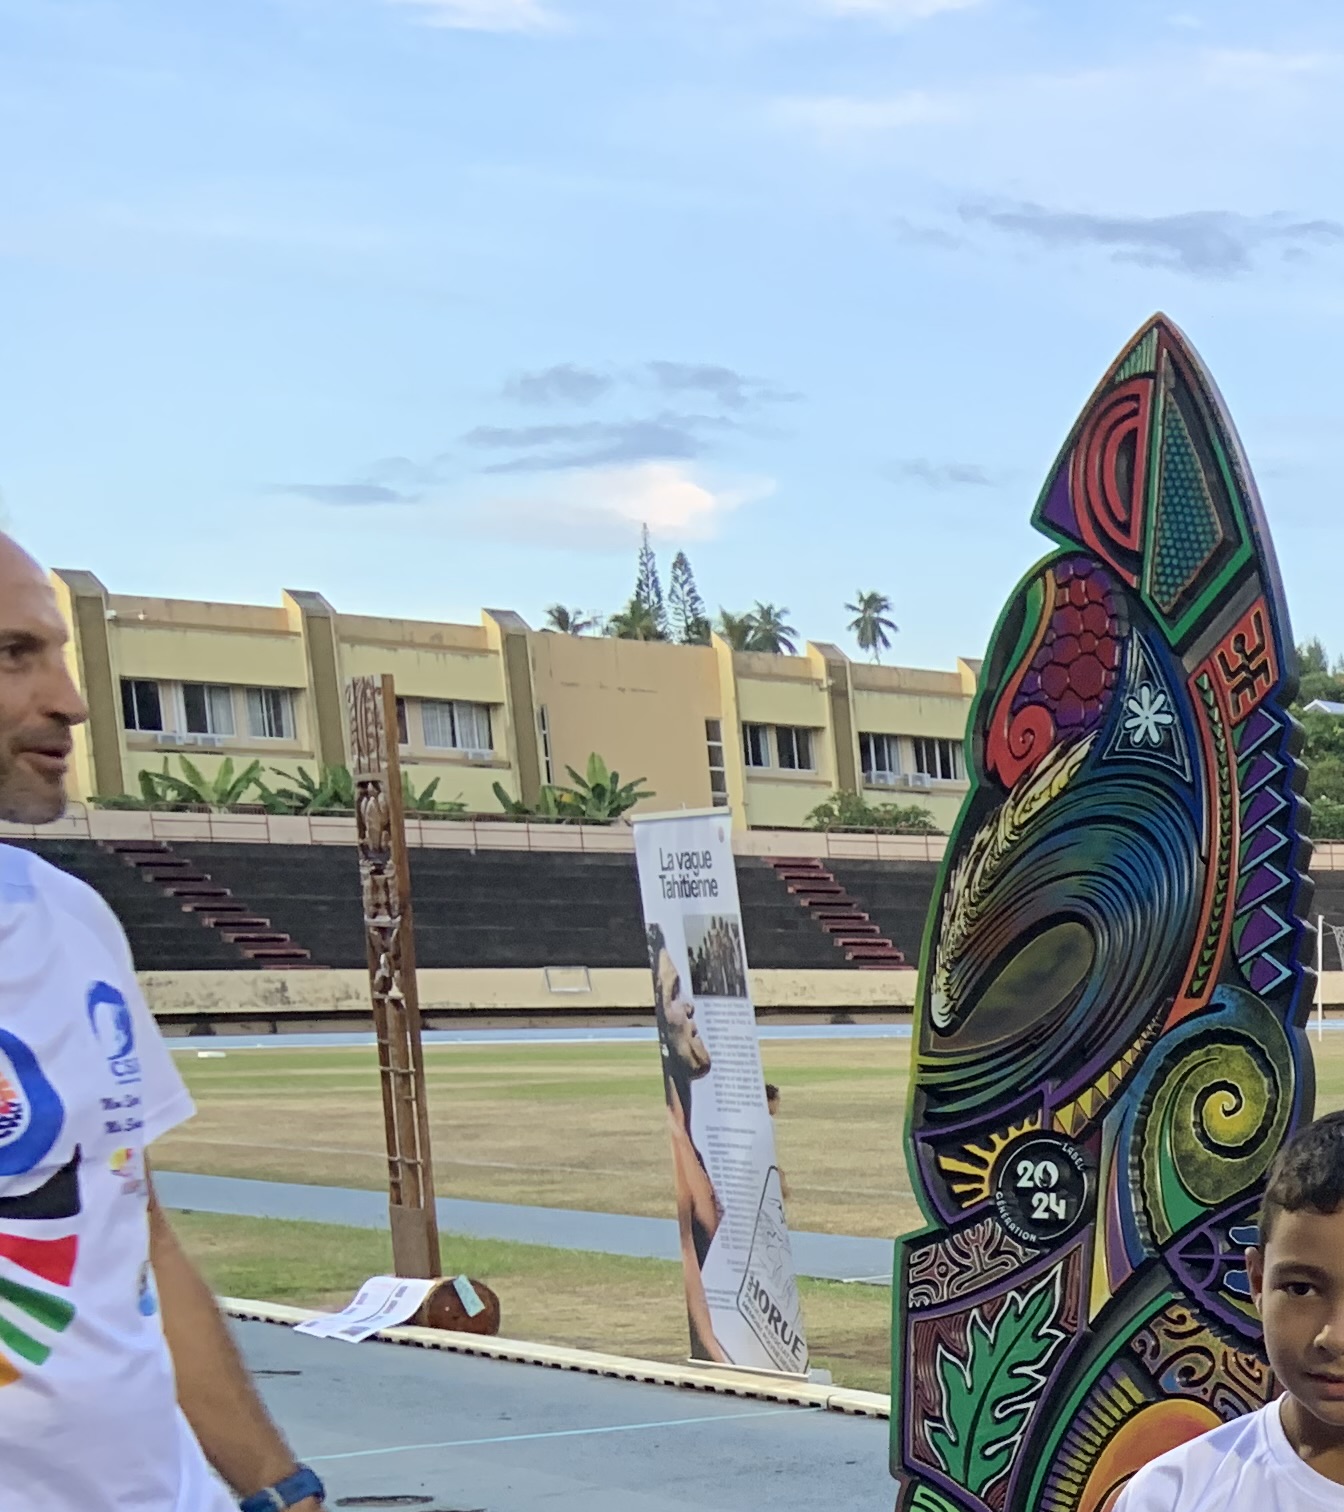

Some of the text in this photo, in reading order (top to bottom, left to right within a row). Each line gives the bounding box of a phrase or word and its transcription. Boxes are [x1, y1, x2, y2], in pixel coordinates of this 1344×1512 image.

[658, 847, 712, 877] La vague
[658, 873, 718, 899] Tahitienne
[1016, 1160, 1059, 1188] 20
[1031, 1192, 1067, 1219] 24
